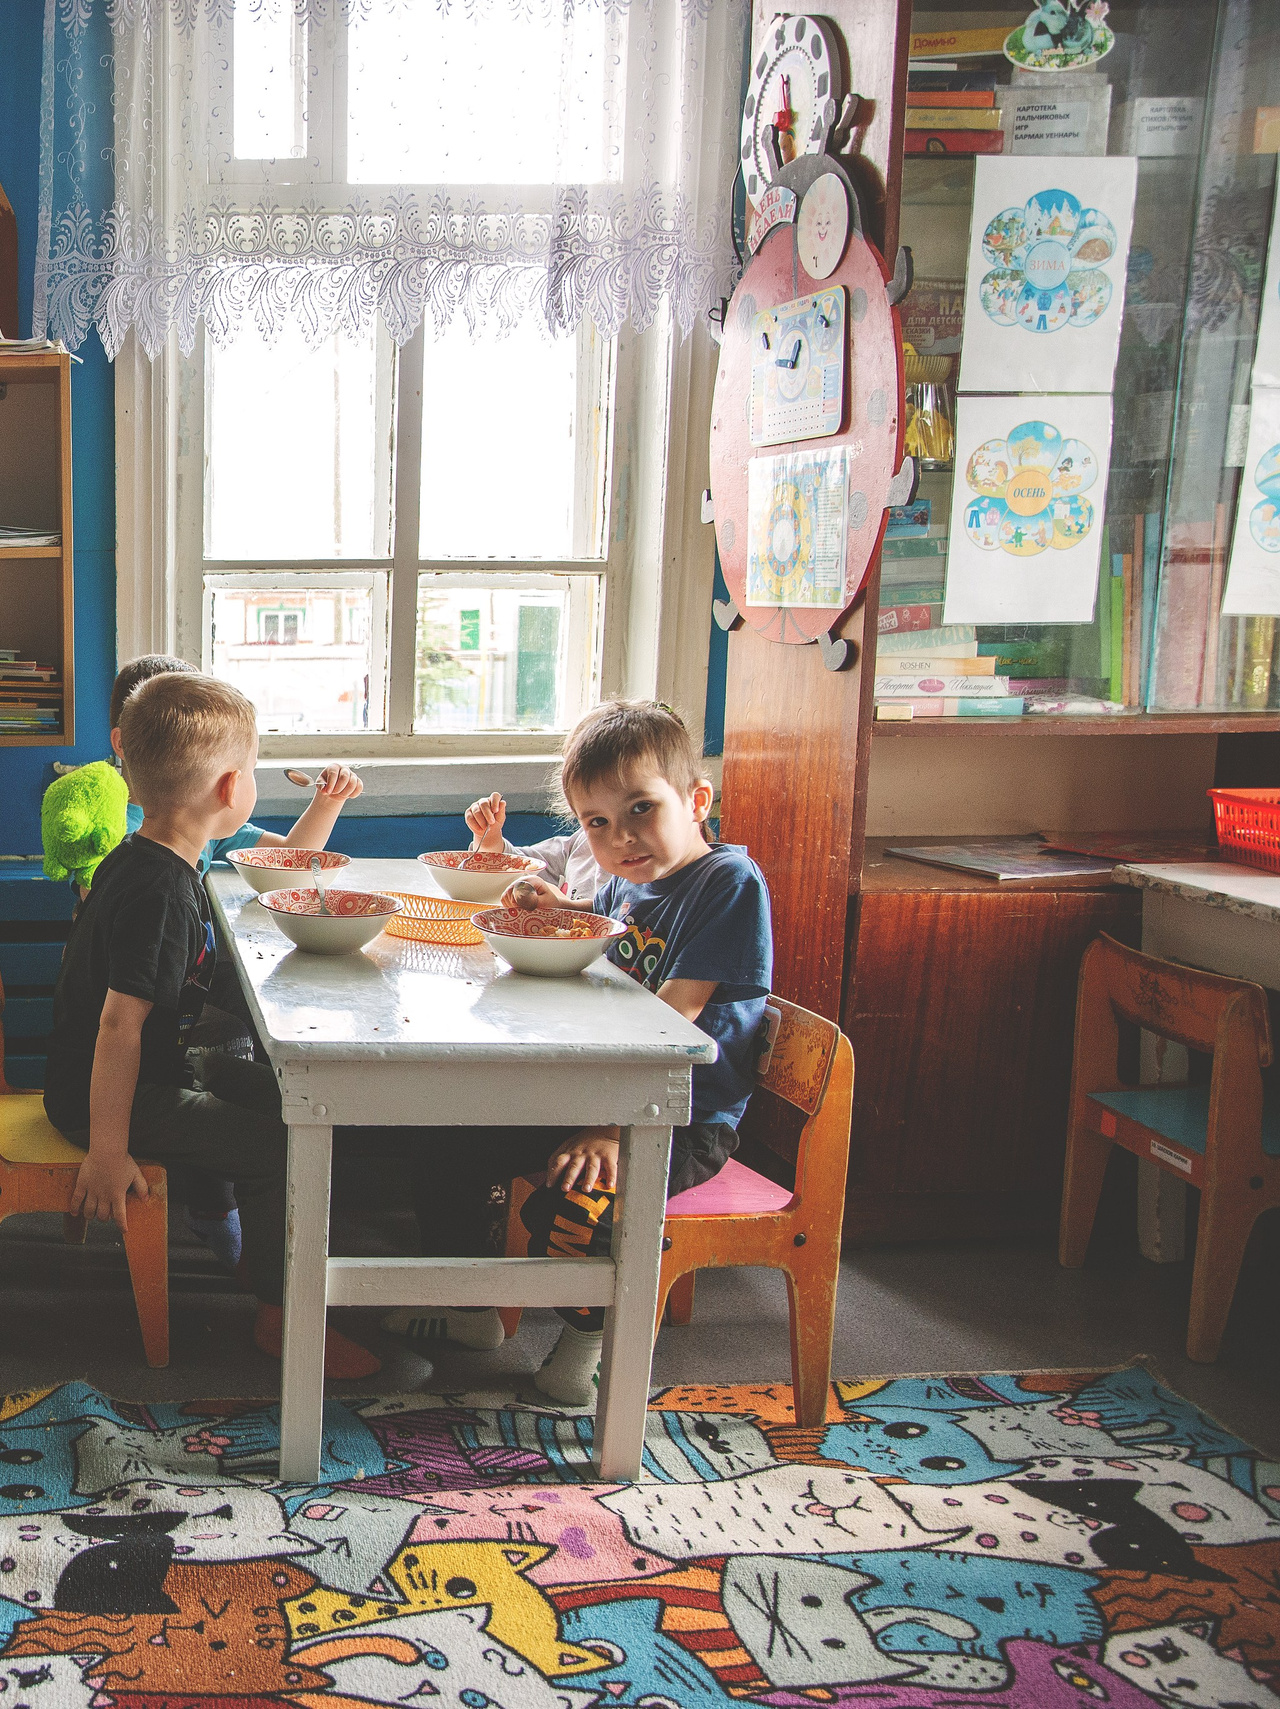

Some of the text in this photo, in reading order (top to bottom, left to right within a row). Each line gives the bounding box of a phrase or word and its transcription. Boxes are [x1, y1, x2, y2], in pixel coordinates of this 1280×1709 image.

[913, 36, 957, 50] Домино
[1016, 104, 1057, 112] КАРТОТЕКА
[1015, 113, 1070, 121] ПАЛЬЧИКОВЫХ
[1045, 131, 1080, 139] УЕННАРЫ
[754, 188, 781, 226] ДЕНЬ
[749, 203, 793, 251] НЕДЕЛИ
[1029, 259, 1066, 271] ЗИМА
[906, 316, 927, 326] ДЛЯ
[1013, 487, 1046, 498] ОСЕНЬ
[900, 661, 931, 669] ROSHEN
